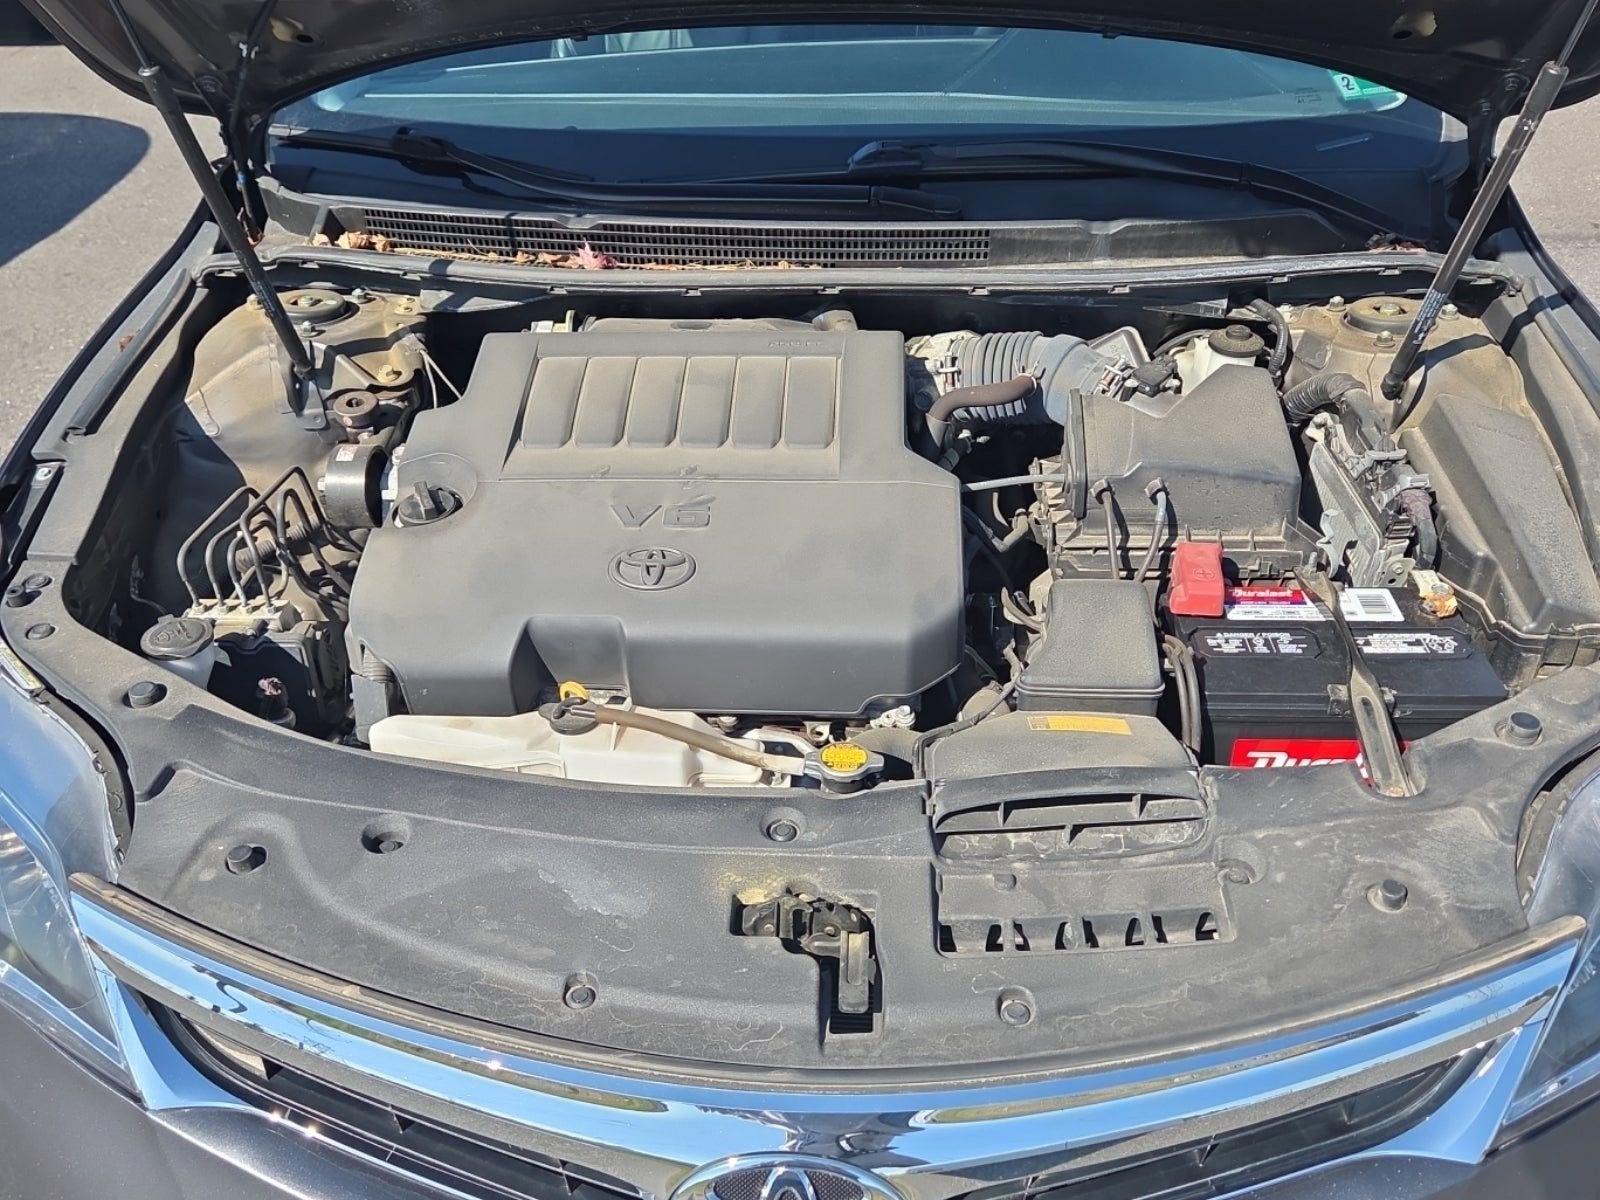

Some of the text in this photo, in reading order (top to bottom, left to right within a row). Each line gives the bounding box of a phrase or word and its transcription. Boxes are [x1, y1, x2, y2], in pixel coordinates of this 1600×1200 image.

[1341, 76, 1355, 90] 2
[610, 504, 711, 529] V6
[1232, 588, 1293, 598] Duralast
